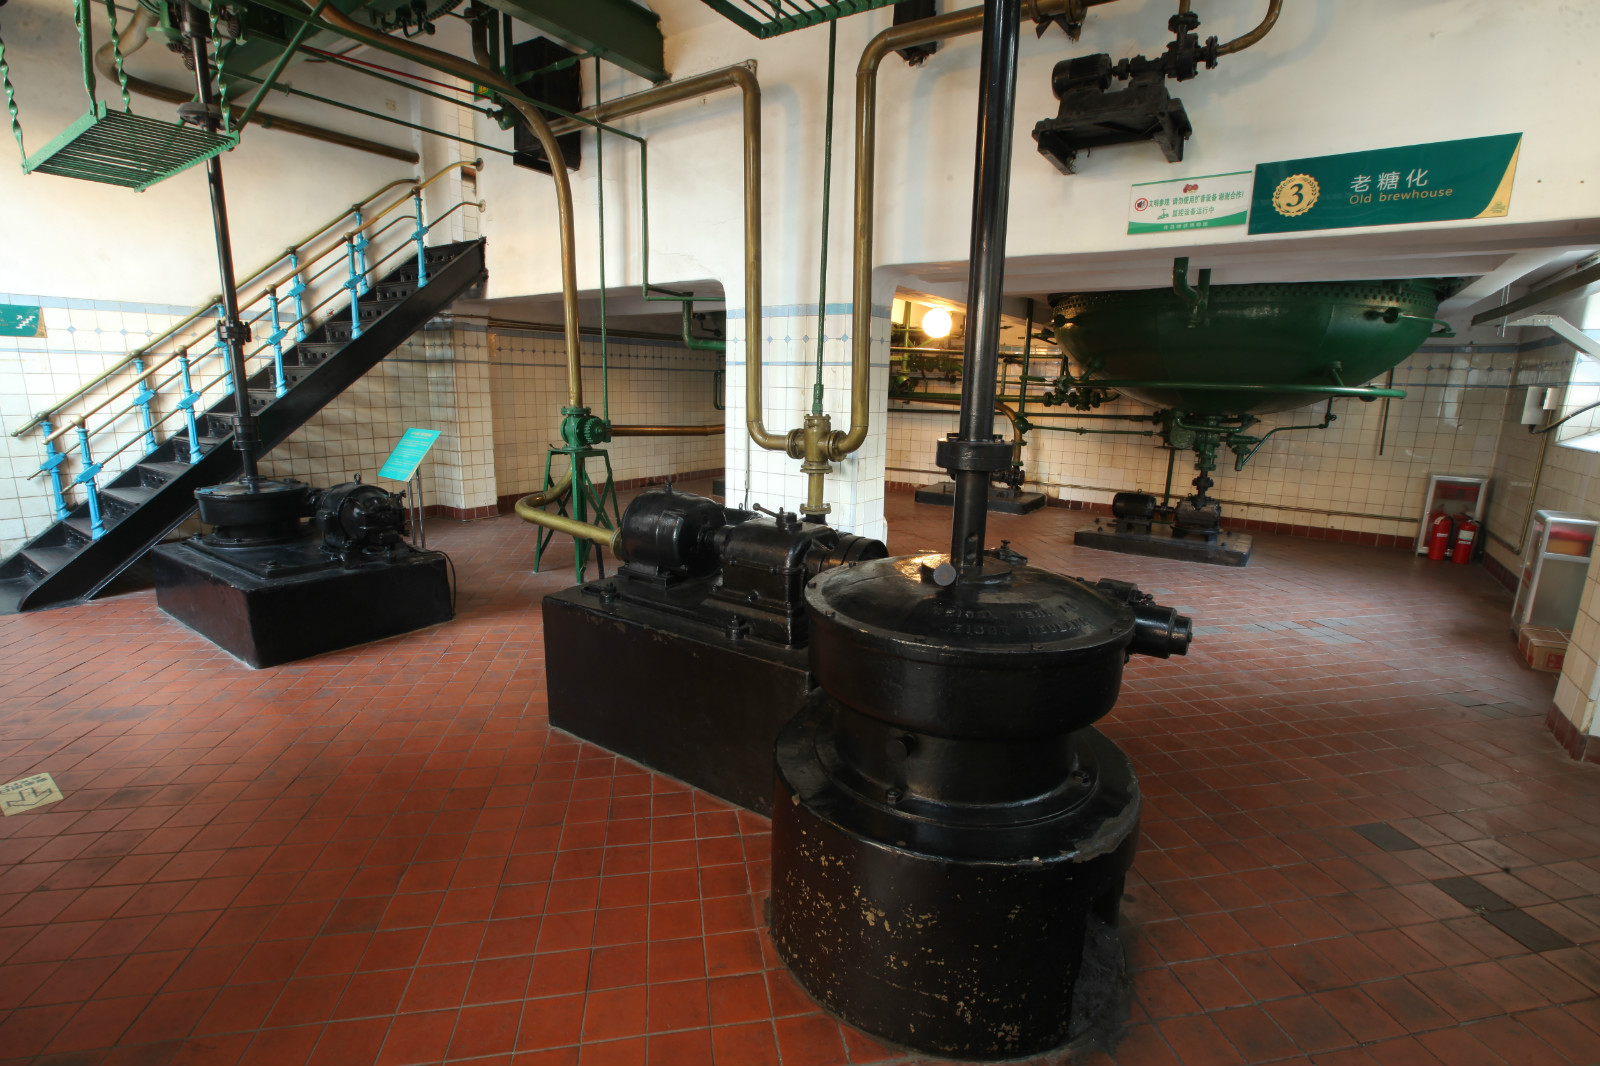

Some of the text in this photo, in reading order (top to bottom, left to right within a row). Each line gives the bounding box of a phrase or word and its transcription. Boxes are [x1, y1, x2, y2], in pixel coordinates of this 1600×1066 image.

[1350, 168, 1428, 193] 老糖化
[1286, 183, 1304, 207] 3
[1350, 186, 1453, 206] Old brewhouse
[1172, 206, 1215, 217] 监控设备运行中
